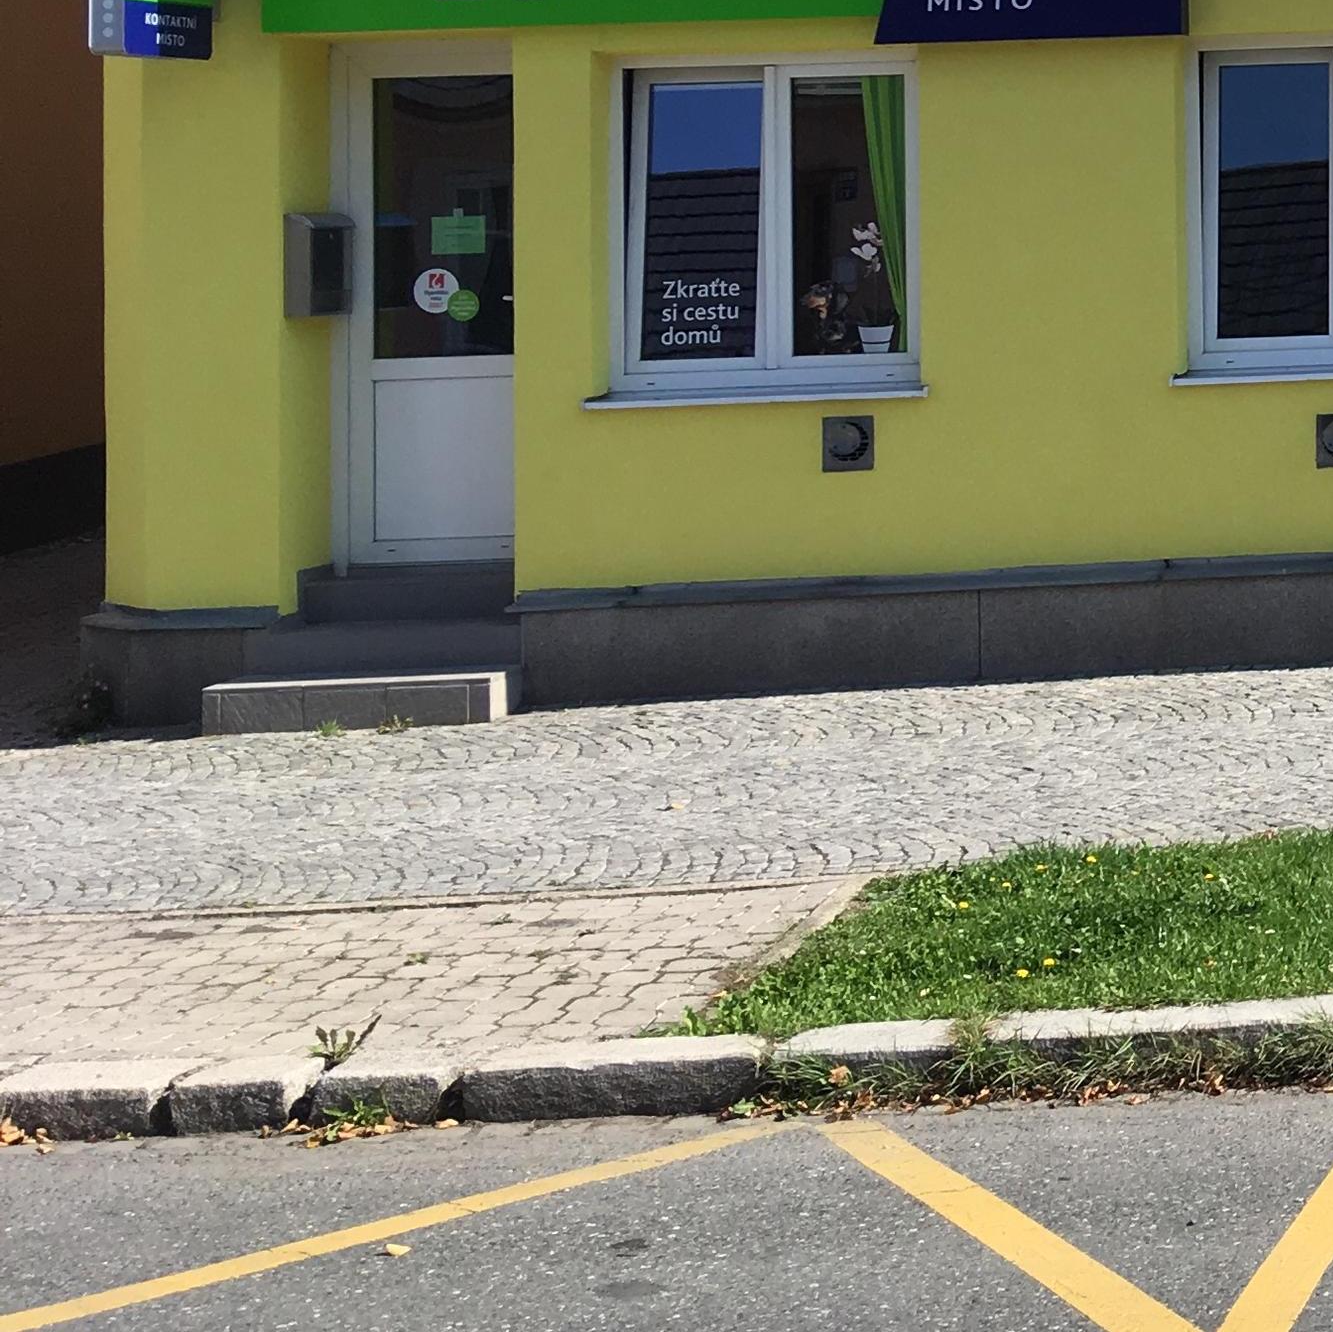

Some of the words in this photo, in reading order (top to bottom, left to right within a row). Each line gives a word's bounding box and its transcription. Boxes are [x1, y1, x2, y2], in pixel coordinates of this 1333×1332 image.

[662, 277, 741, 299] Zkraťte
[661, 303, 678, 322] si
[683, 303, 739, 321] cestu
[661, 324, 721, 345] domů
